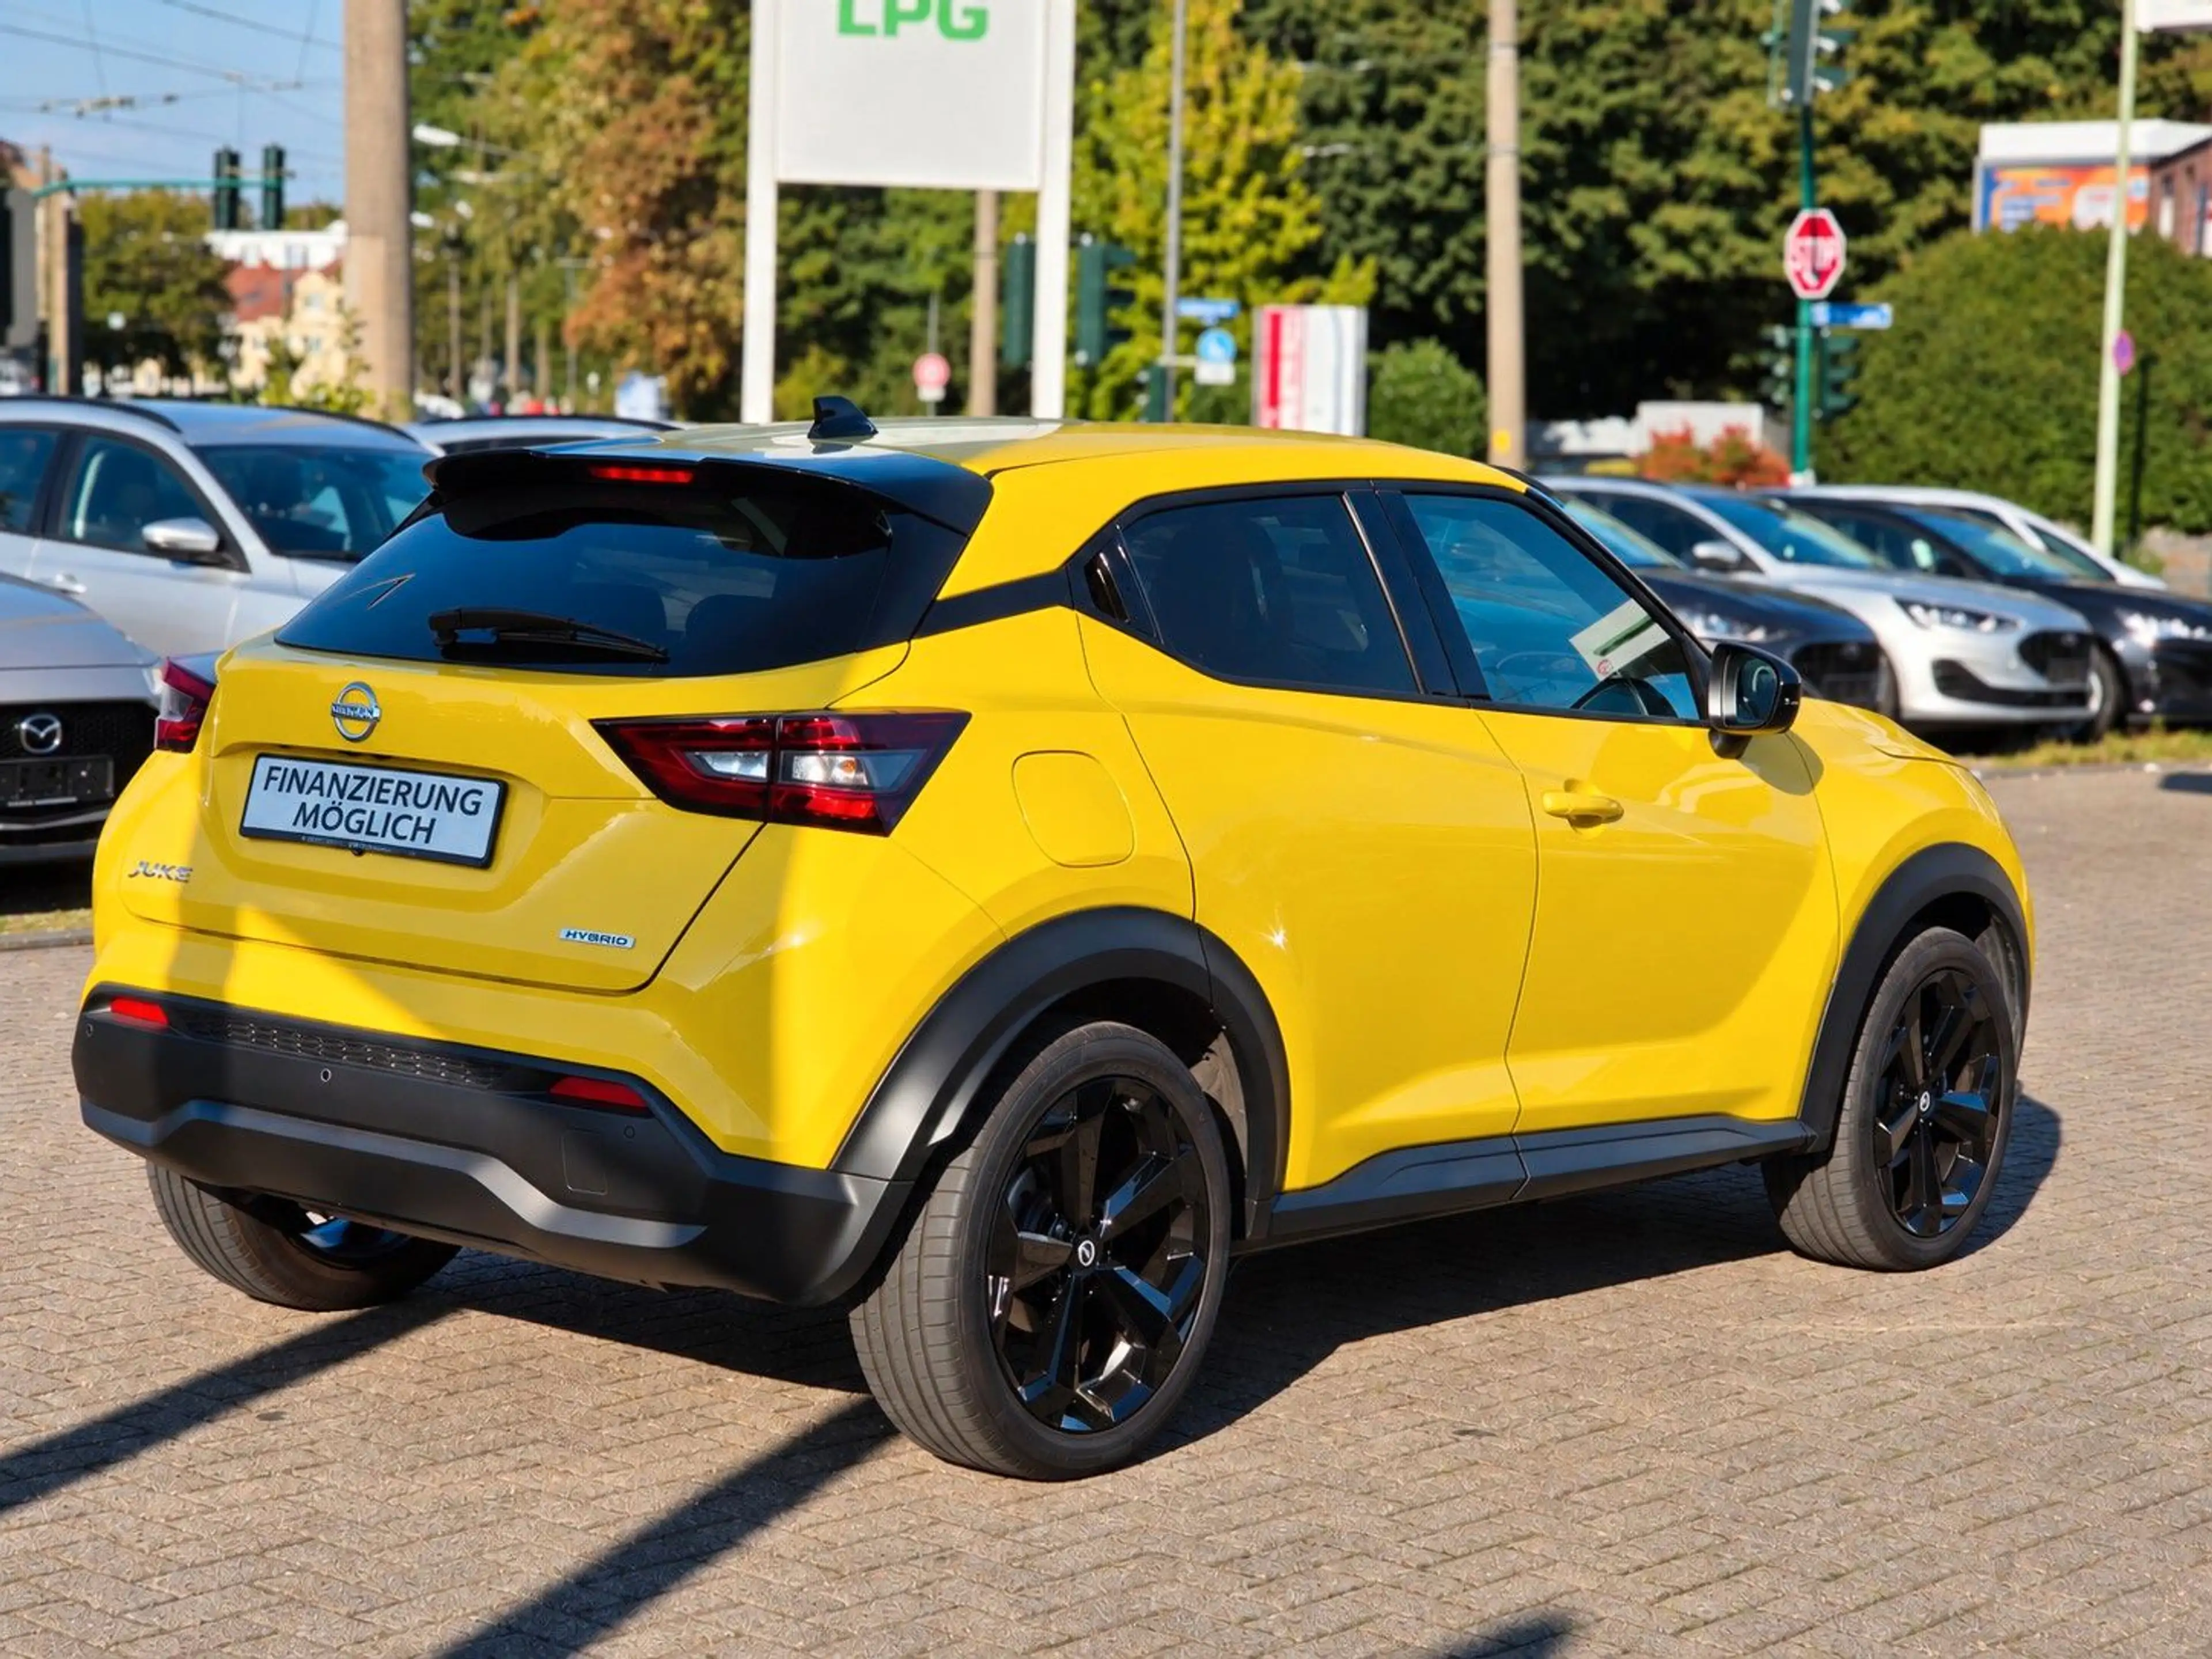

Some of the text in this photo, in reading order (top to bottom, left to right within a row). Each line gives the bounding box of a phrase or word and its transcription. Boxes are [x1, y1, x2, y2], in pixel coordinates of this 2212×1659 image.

[839, 0, 987, 40] LPG
[263, 766, 484, 816] FINANZIERUNG
[292, 801, 437, 844] MÖGLICH
[128, 861, 193, 882] JUKE
[565, 930, 628, 945] HYBRID
